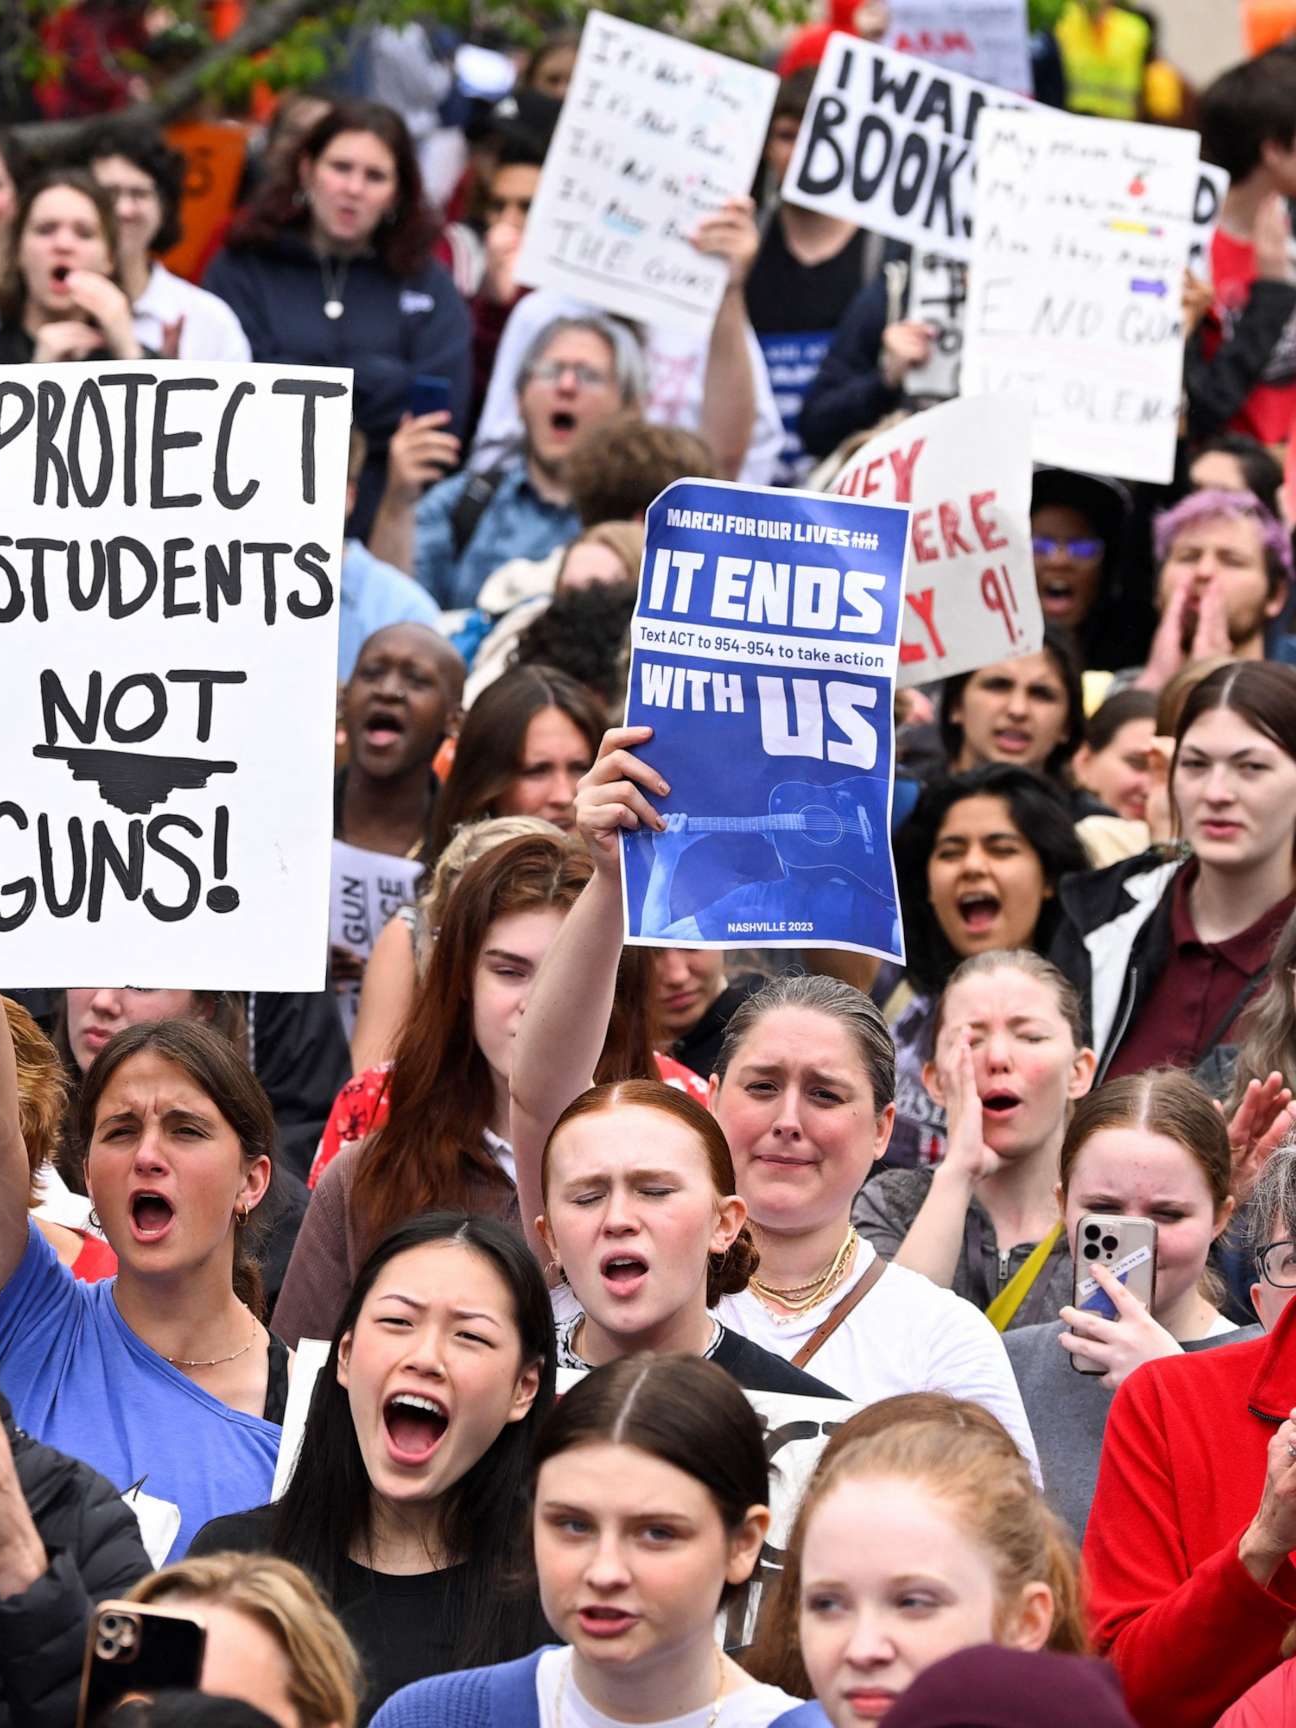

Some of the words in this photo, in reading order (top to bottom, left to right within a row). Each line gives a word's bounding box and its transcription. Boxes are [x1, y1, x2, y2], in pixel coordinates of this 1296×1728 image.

[837, 49, 853, 90] I
[666, 507, 725, 534] MARCH
[726, 514, 757, 538] FOR
[757, 518, 792, 541] OUR
[794, 522, 850, 548] LIVES
[648, 548, 705, 614] IT
[710, 556, 885, 635] ENDS
[639, 626, 667, 645] Text
[668, 630, 694, 646] ACT
[697, 633, 711, 649] to
[714, 636, 775, 659] 954-954
[778, 643, 793, 660] to
[796, 645, 831, 664] take
[834, 647, 885, 670] action
[39, 668, 249, 746] NOT
[641, 662, 746, 714] WITH
[757, 674, 879, 770] US
[341, 875, 369, 945] GUN
[727, 921, 786, 933] NASHVILLE
[787, 921, 814, 932] 2023
